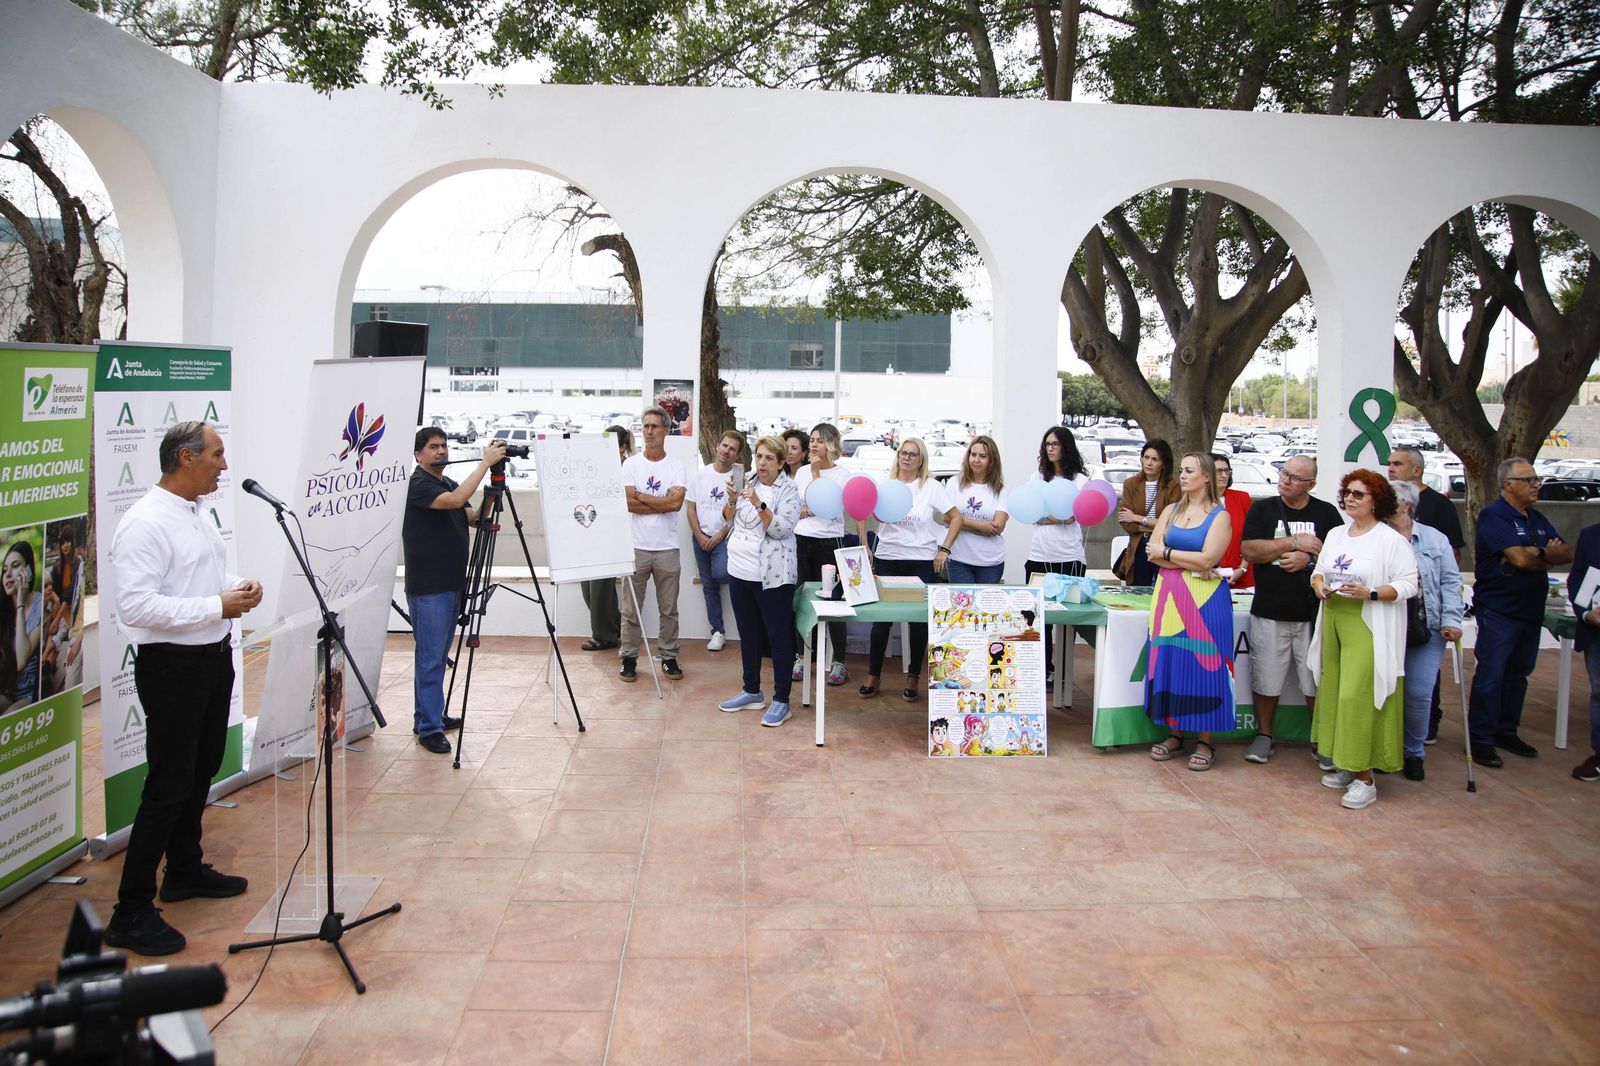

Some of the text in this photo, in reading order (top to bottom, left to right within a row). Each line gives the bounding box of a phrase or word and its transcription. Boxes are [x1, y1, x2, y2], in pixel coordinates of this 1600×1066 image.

[133, 369, 162, 377] Andalucía
[54, 384, 83, 393] Teléfono de
[52, 394, 85, 404] la esperanza
[50, 405, 78, 415] Almería
[0, 438, 64, 457] AMOS DEL
[114, 444, 138, 454] FAISEM
[0, 458, 84, 482] R EMOCIONAL
[305, 460, 407, 498] PSICOLOGÍA
[114, 504, 131, 514] FAISE
[308, 486, 390, 518] en ACCIÓN
[112, 674, 122, 682] Junta
[118, 684, 138, 698] FAISE
[0, 708, 54, 745] 6 99 99
[114, 736, 125, 745] Junta
[16, 776, 22, 784] Y
[22, 760, 54, 782] TALLERES
[54, 752, 70, 767] PARA
[21, 778, 47, 796] mejorar
[48, 775, 54, 783] la
[12, 806, 18, 816] la
[20, 795, 38, 812] salud
[39, 778, 72, 802] emocional
[8, 835, 15, 846] al
[16, 828, 30, 841] 950
[30, 823, 38, 834] 26
[40, 818, 48, 828] 07
